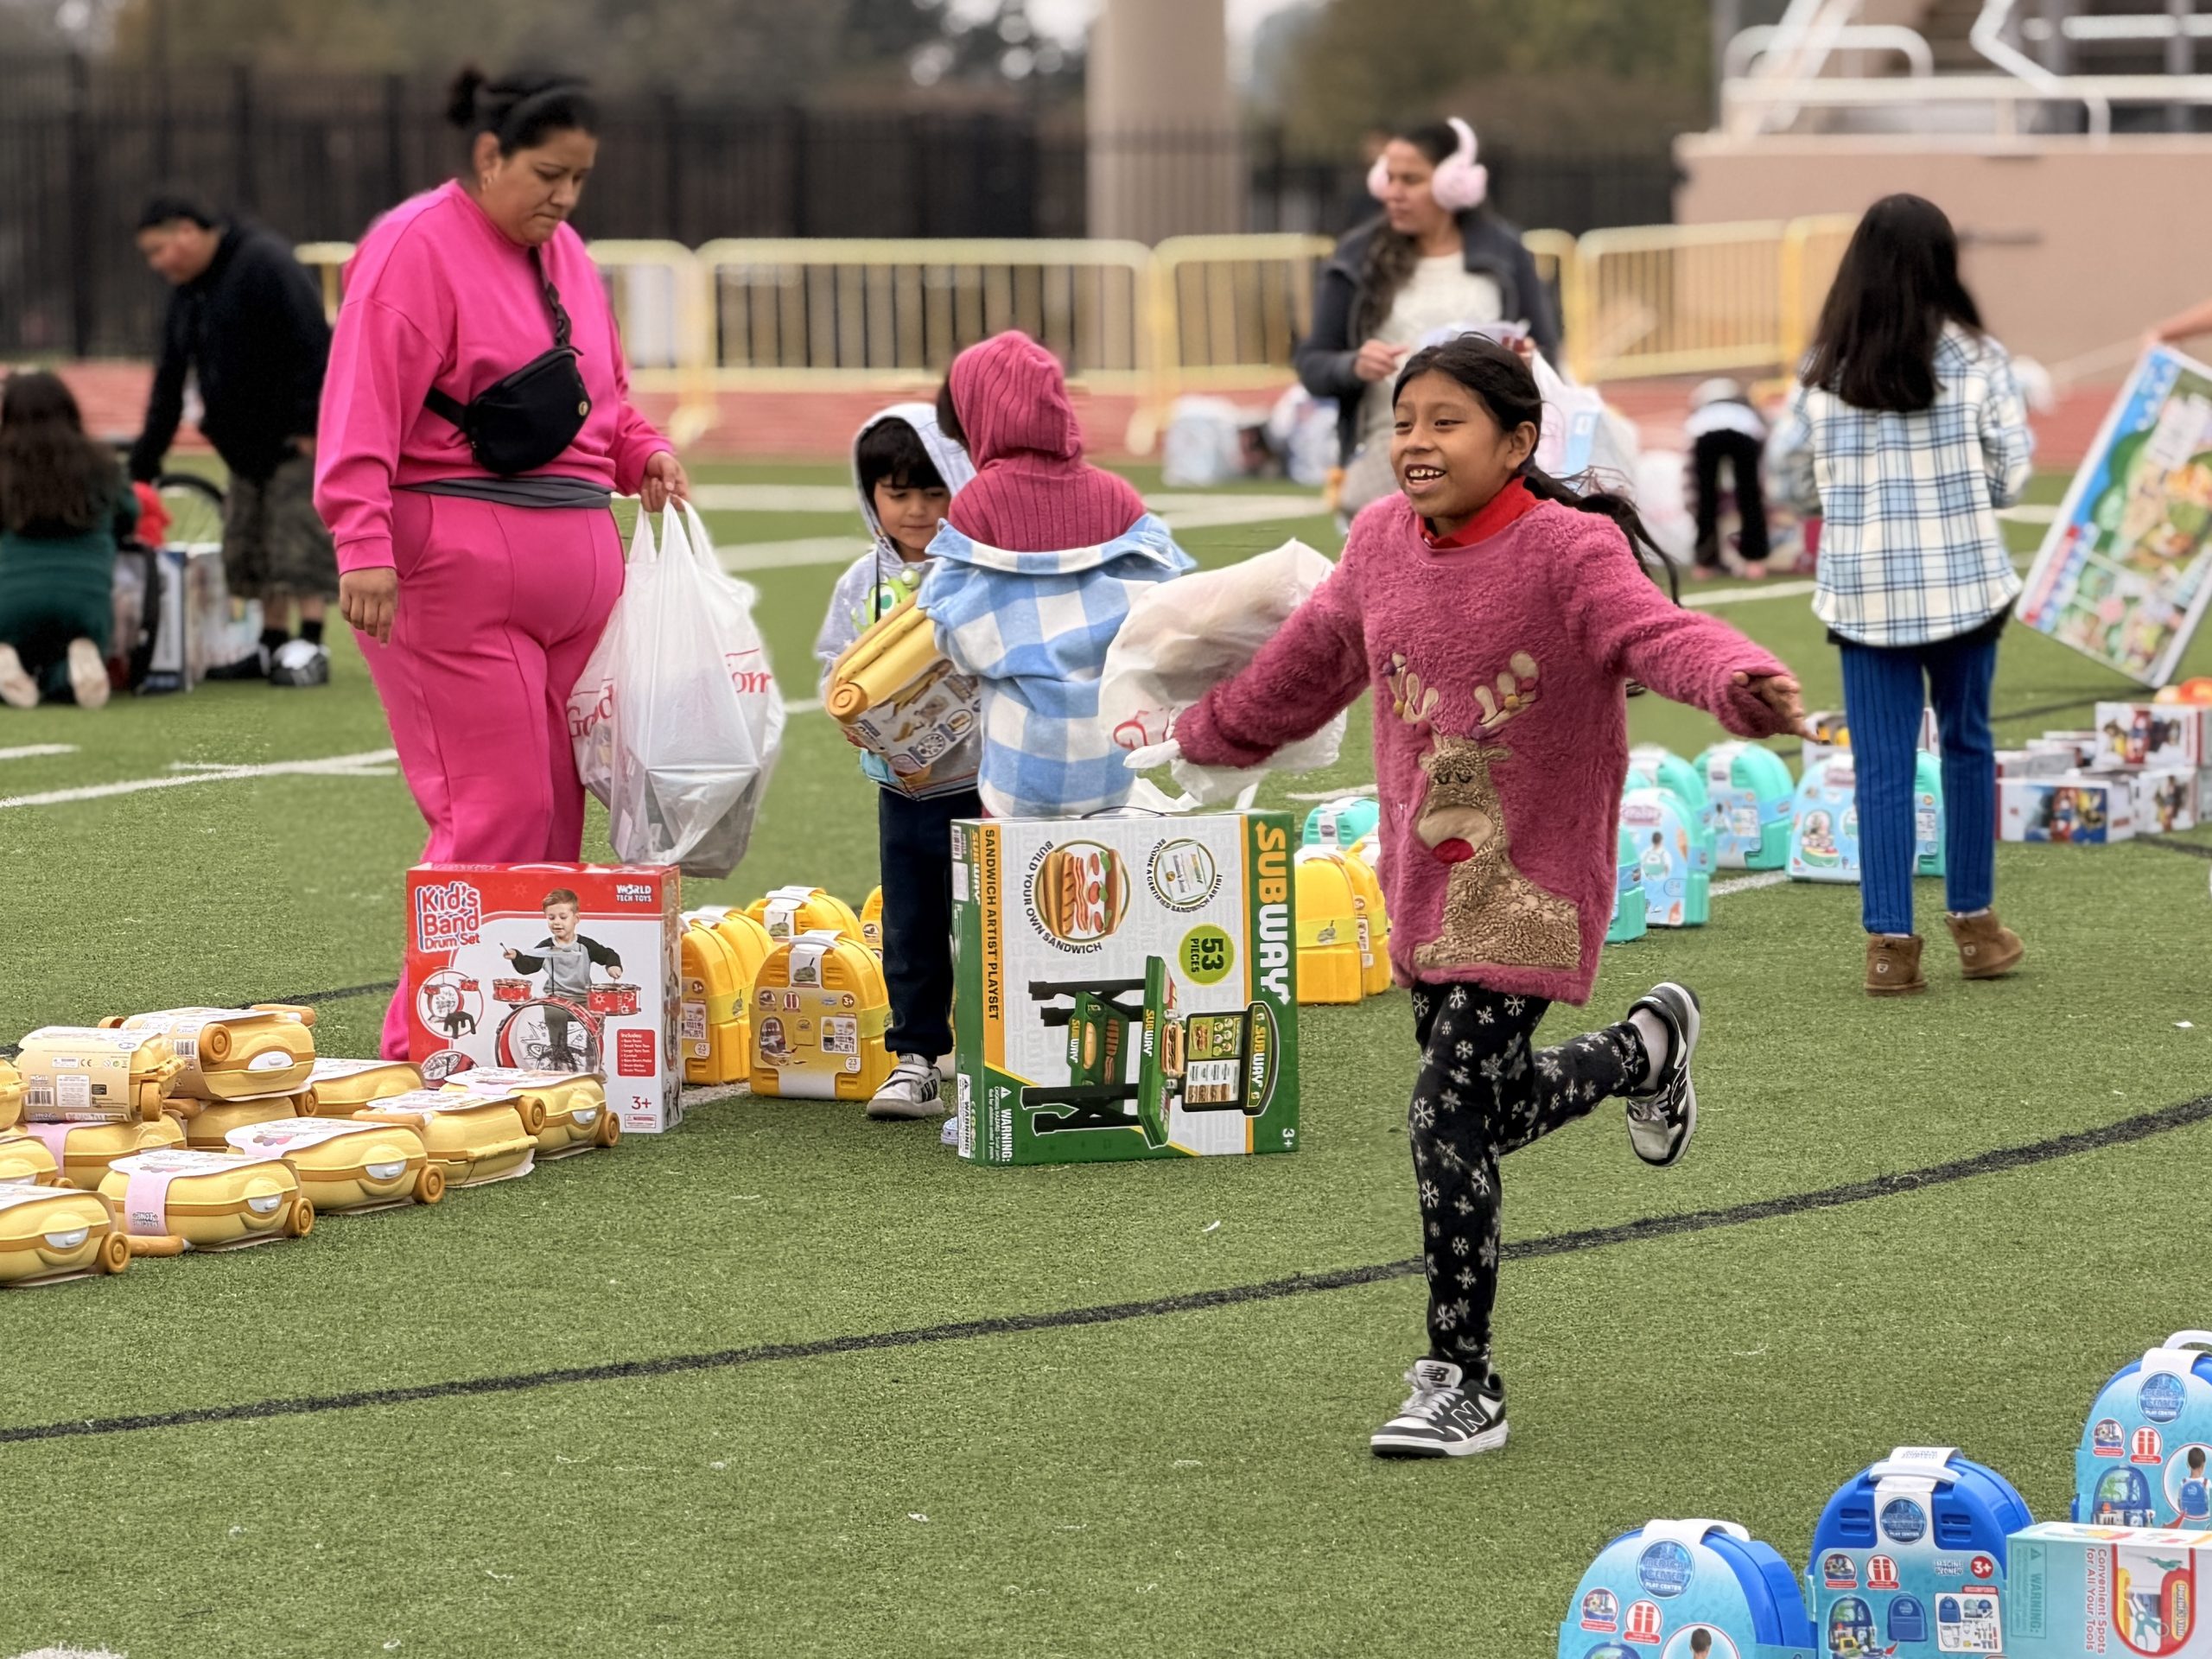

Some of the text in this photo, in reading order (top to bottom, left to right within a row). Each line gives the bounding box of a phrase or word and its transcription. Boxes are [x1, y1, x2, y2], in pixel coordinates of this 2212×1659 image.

[421, 885, 479, 913] Kid's
[616, 884, 652, 894] WORLD
[635, 894, 652, 903] TOYS
[1023, 841, 1103, 954] BUILD YOUR OWN SANDWICH
[423, 906, 480, 936] Band
[986, 830, 999, 1020] SANDWICH ARTIST PLAYSET
[1255, 821, 1291, 1006] SUBWAY
[424, 932, 480, 950] Drum Set
[1191, 938, 1199, 973] PIECES
[1201, 938, 1224, 970] 53
[1068, 1019, 1080, 1064] SUBWAY
[1144, 1009, 1155, 1057] SUBWAY
[1251, 1024, 1266, 1088] SUBWAY
[632, 1096, 652, 1109] 3+
[1001, 1109, 1013, 1162] WARNING:
[1282, 1128, 1295, 1147] 3+
[1974, 1560, 1992, 1574] 3+
[2031, 1573, 2043, 1633] WARNING:
[2086, 1548, 2096, 1650] for All Your Tools
[2097, 1548, 2107, 1654] Convenient Spots
